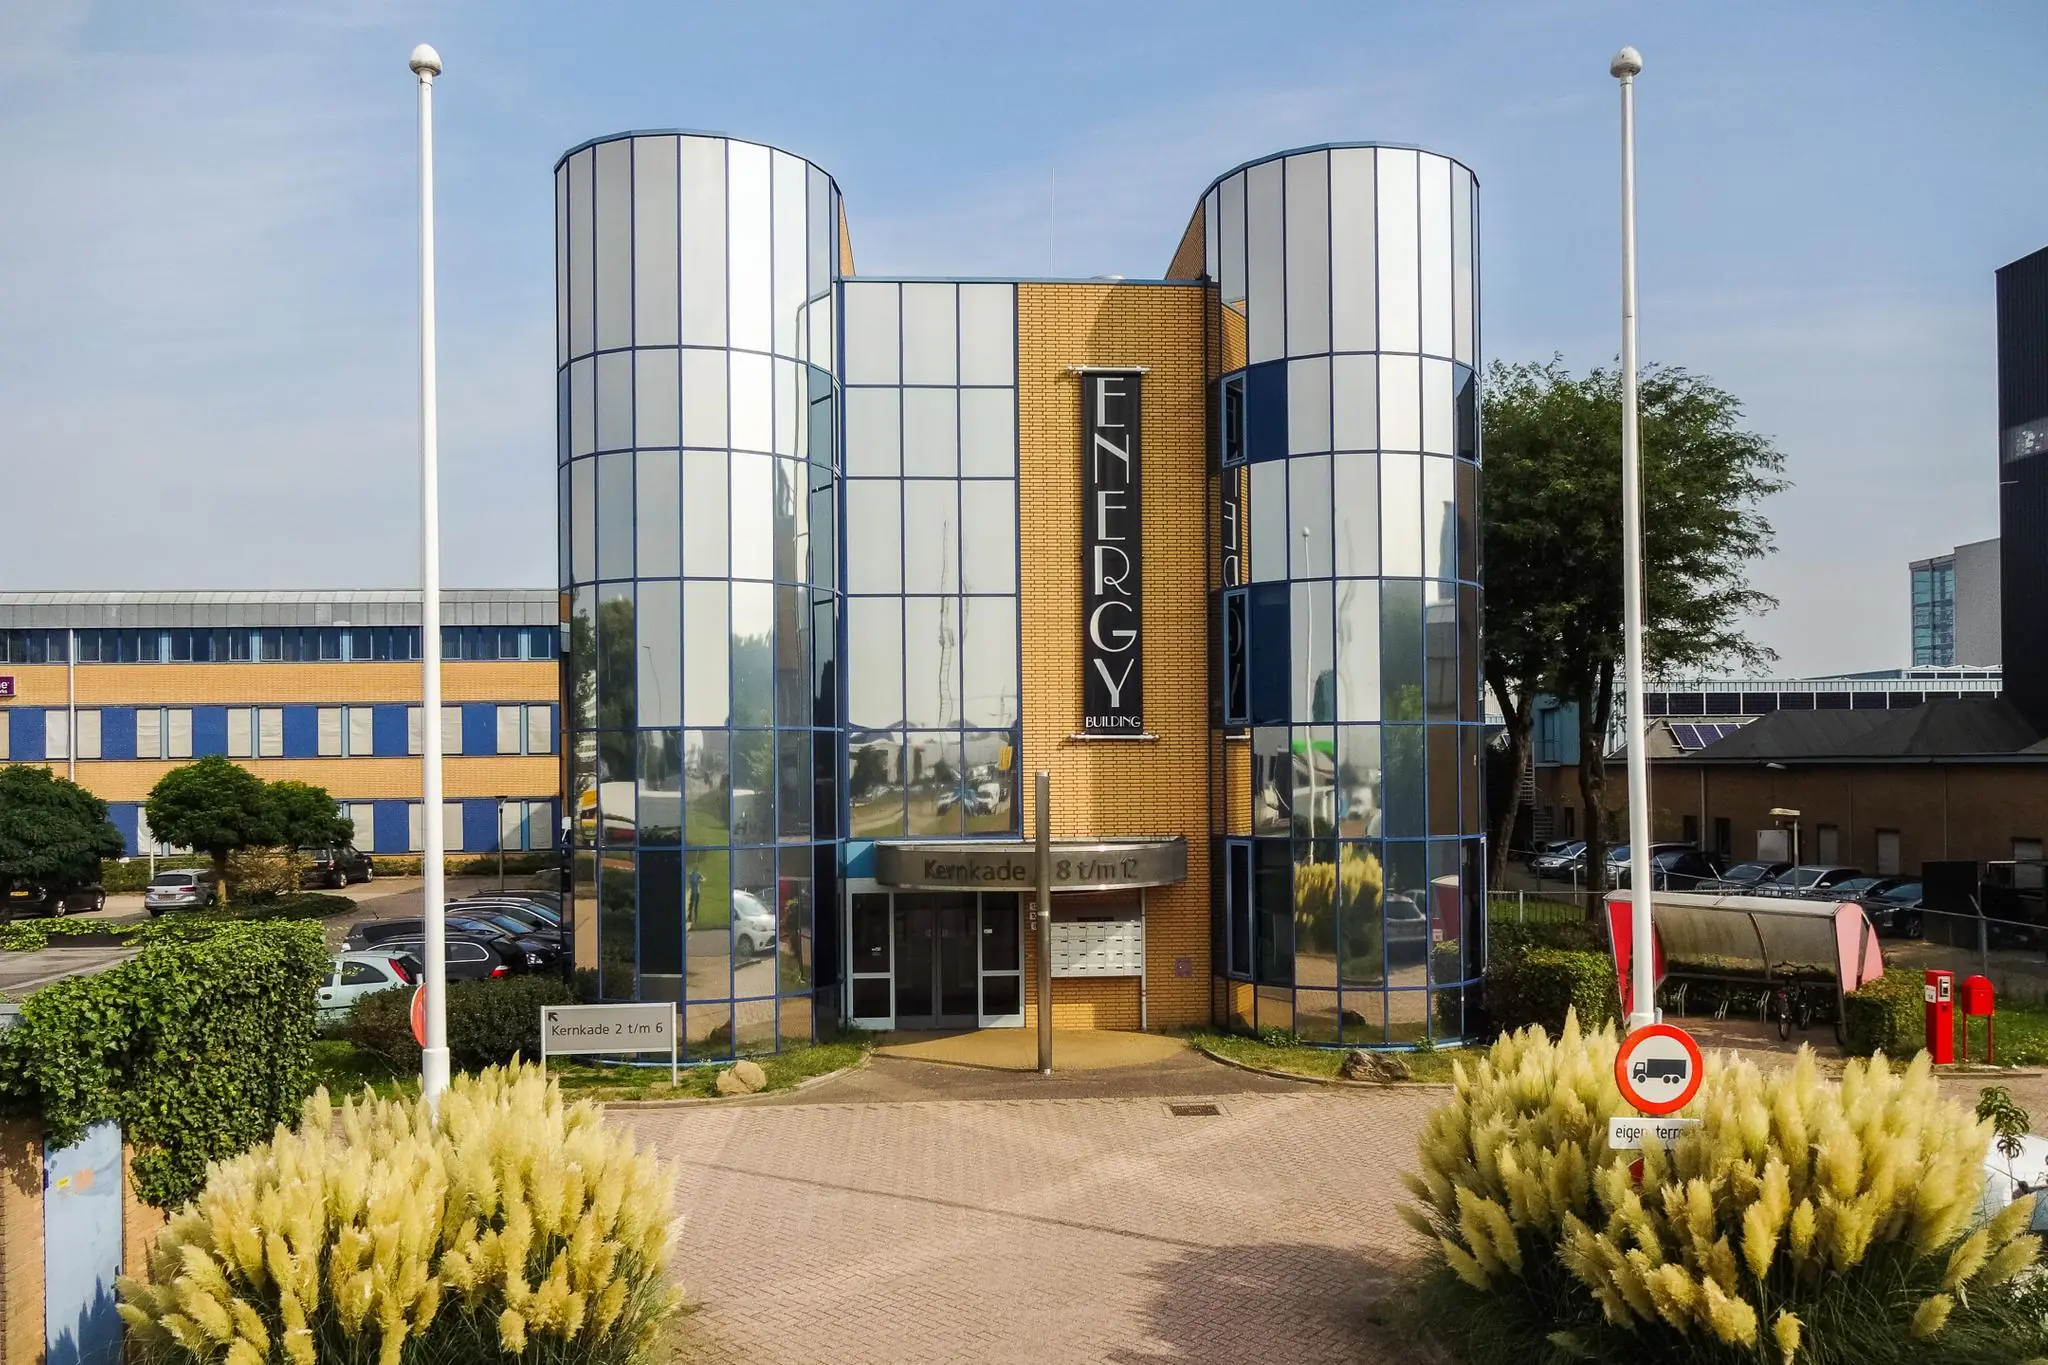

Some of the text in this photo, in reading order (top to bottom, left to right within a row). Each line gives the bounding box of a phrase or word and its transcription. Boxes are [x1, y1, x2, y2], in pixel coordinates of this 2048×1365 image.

[1089, 377, 1137, 707] ENERGY
[1085, 715, 1141, 728] BUILDING
[924, 855, 1139, 881] Kernkade 8 t/m 12
[551, 1022, 663, 1036] Kernkade 2 t/m 6
